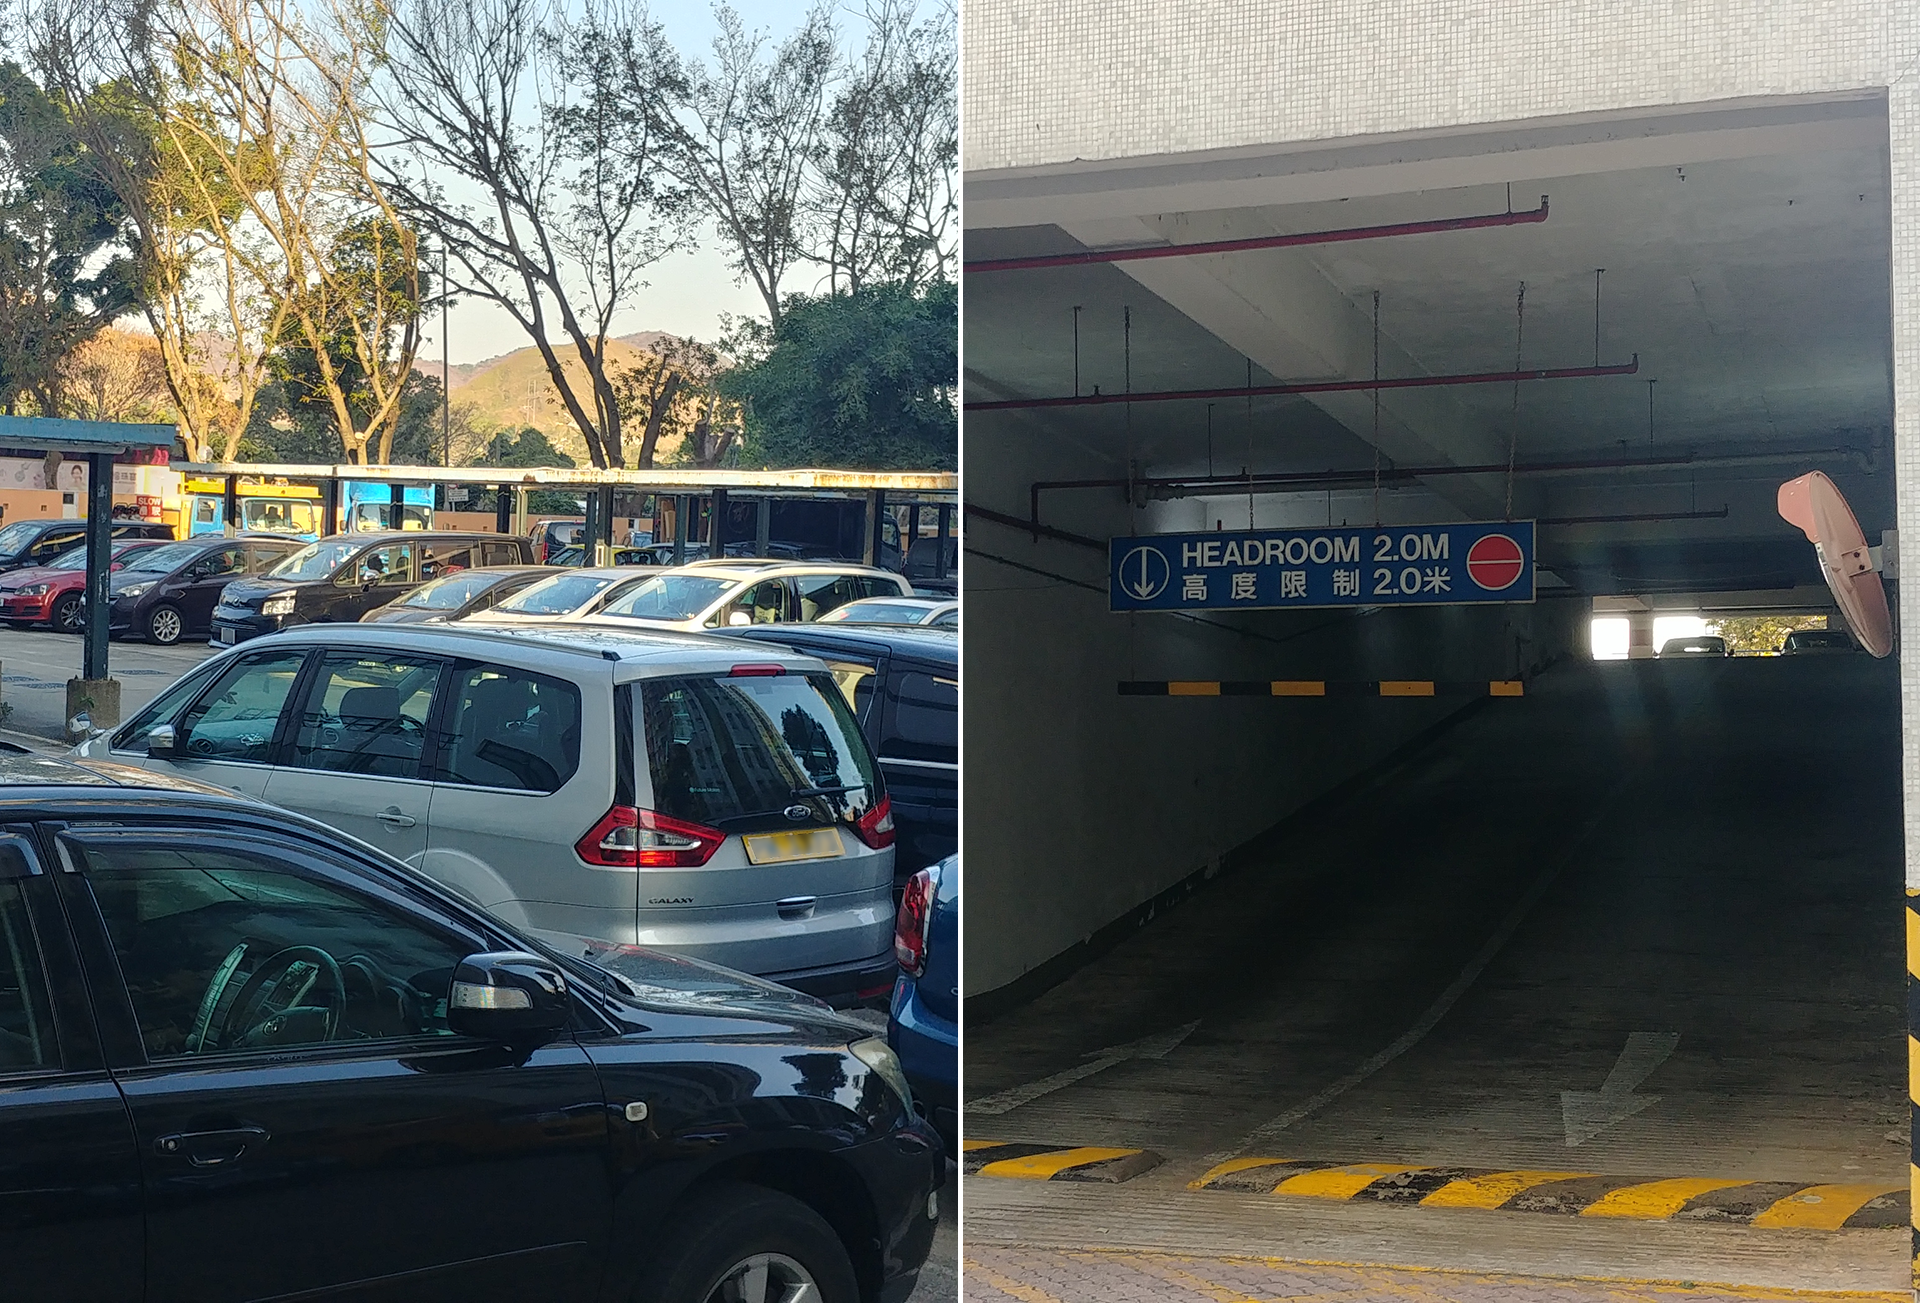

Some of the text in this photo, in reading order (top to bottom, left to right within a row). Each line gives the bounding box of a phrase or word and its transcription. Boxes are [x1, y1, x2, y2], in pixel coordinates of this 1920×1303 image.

[138, 497, 161, 506] SLOW
[1182, 533, 1449, 568] HEADROOM 2.0M
[1182, 566, 1451, 601] 高度限制 2.0米
[648, 897, 694, 905] GALAXY
